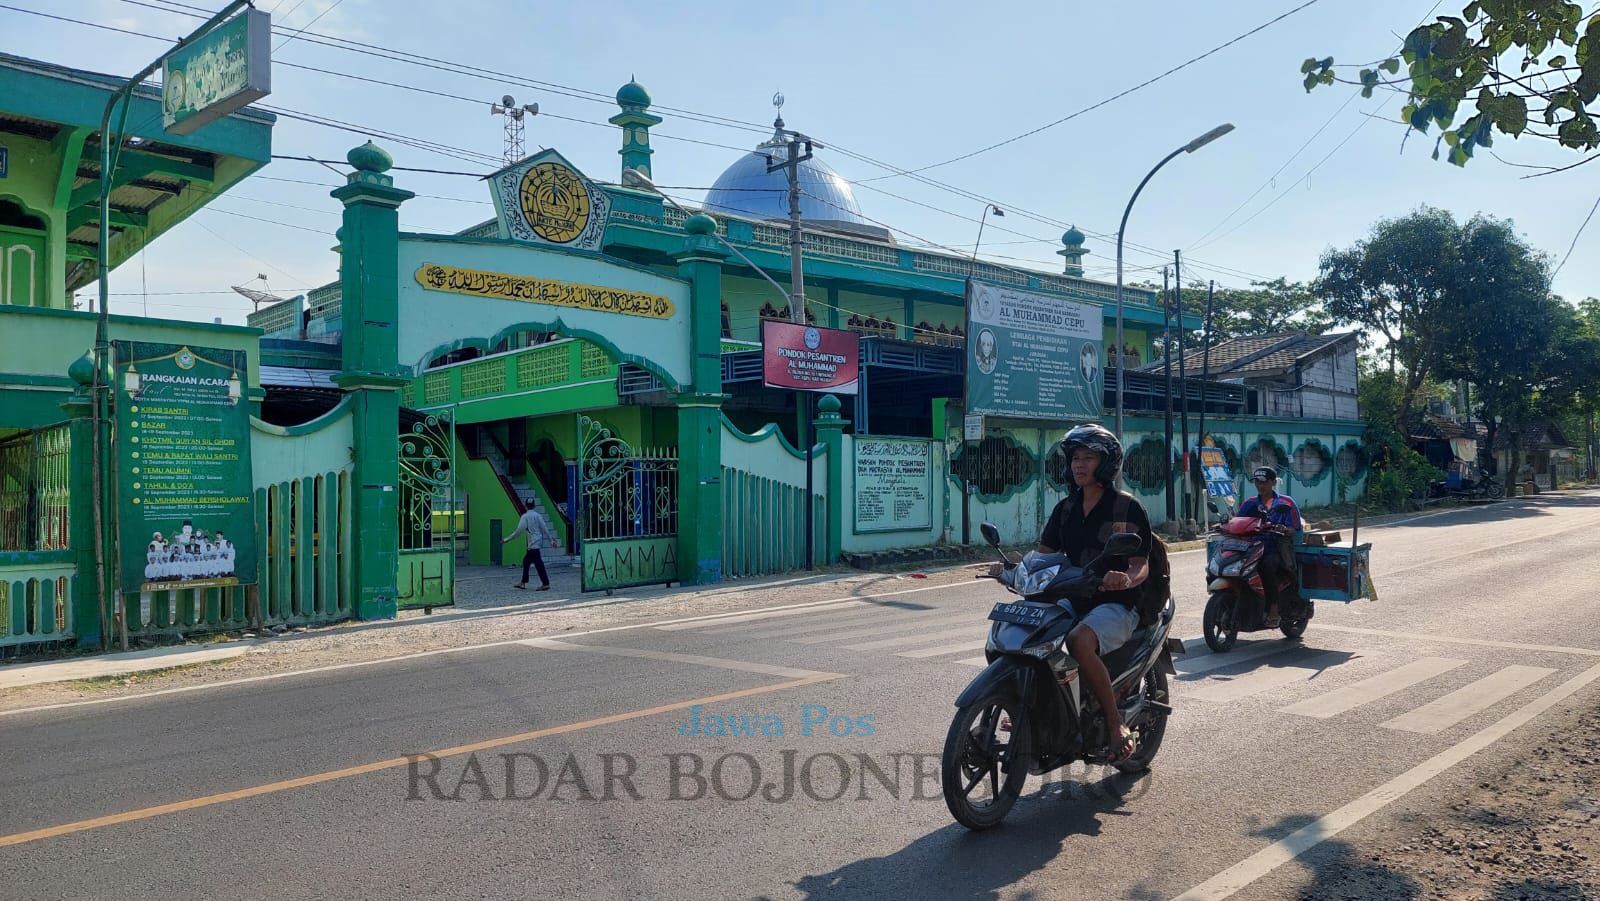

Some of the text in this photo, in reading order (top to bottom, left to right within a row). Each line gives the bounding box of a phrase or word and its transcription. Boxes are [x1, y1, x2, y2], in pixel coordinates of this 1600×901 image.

[1000, 307, 1010, 317] AL
[1013, 309, 1062, 325] MUHAMMAD
[1064, 317, 1085, 328] CEPU
[778, 348, 846, 364] PONDOK PESANTREN
[788, 360, 837, 372] AL MUHAMMAD
[142, 374, 230, 386] RANGKAIAN ACARA
[1030, 608, 1045, 618] ZN
